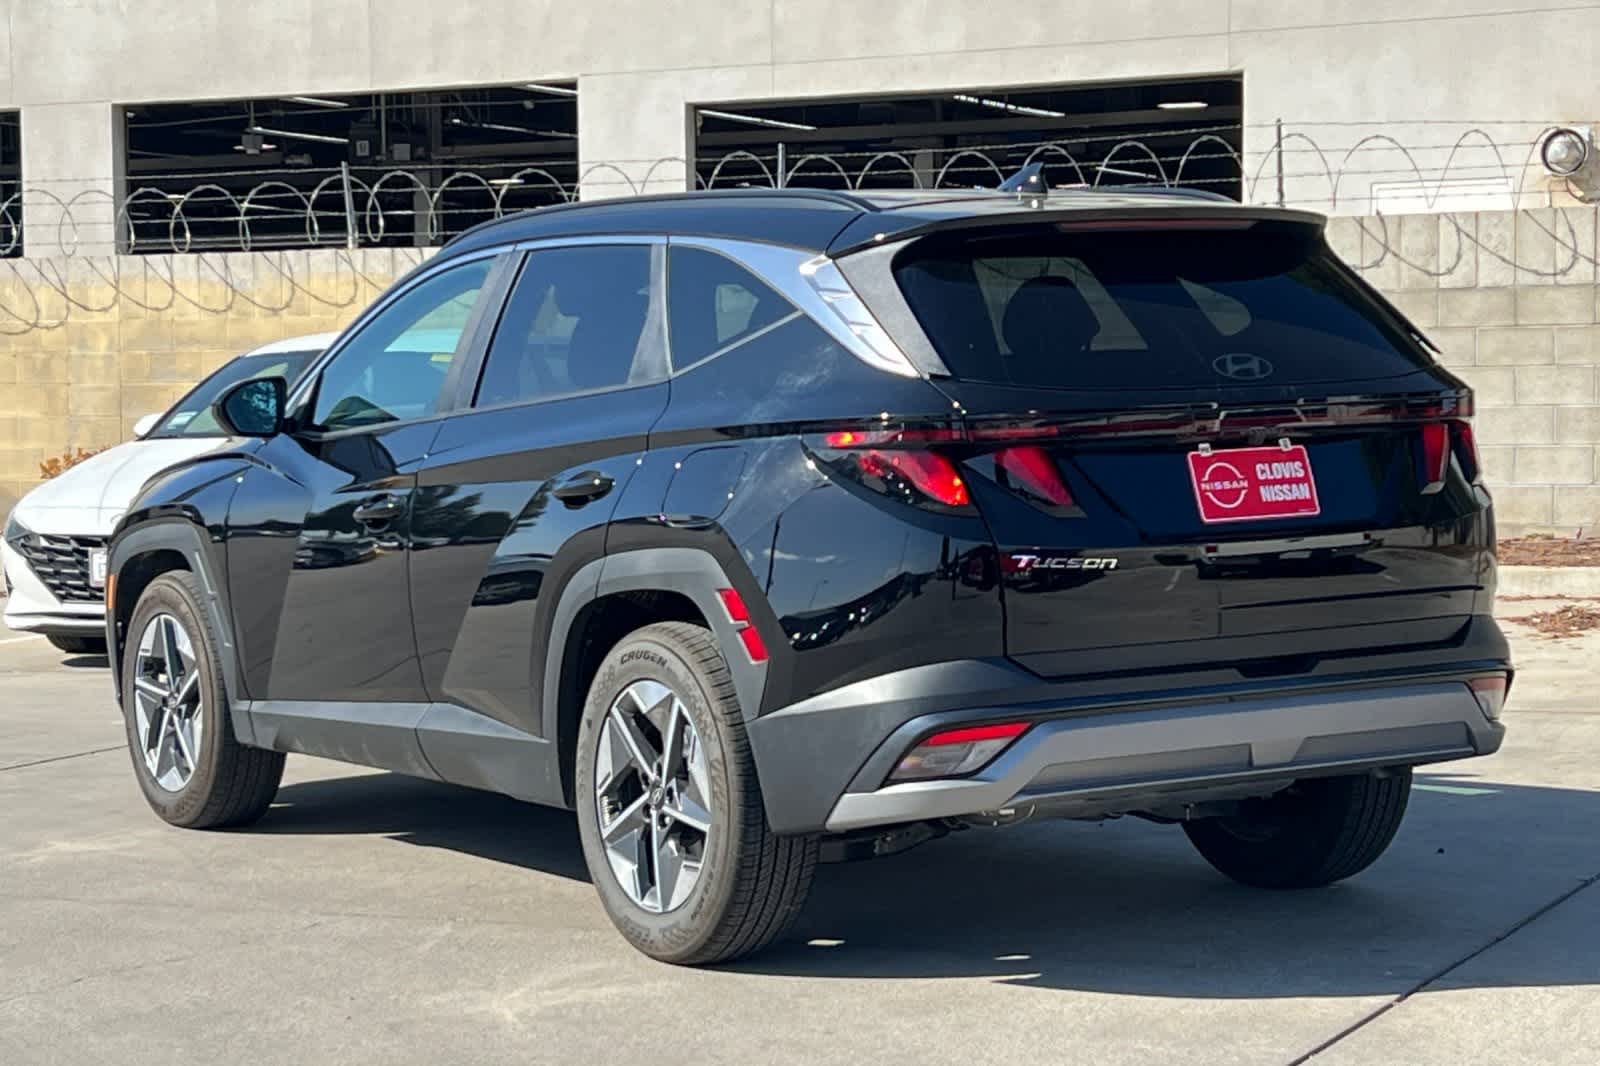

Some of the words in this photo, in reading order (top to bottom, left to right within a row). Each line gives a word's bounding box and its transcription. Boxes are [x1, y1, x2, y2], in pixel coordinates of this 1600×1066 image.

[1255, 461, 1305, 480] CLOVIS
[1201, 480, 1248, 490] NISSAN
[1259, 483, 1311, 502] NISSAN
